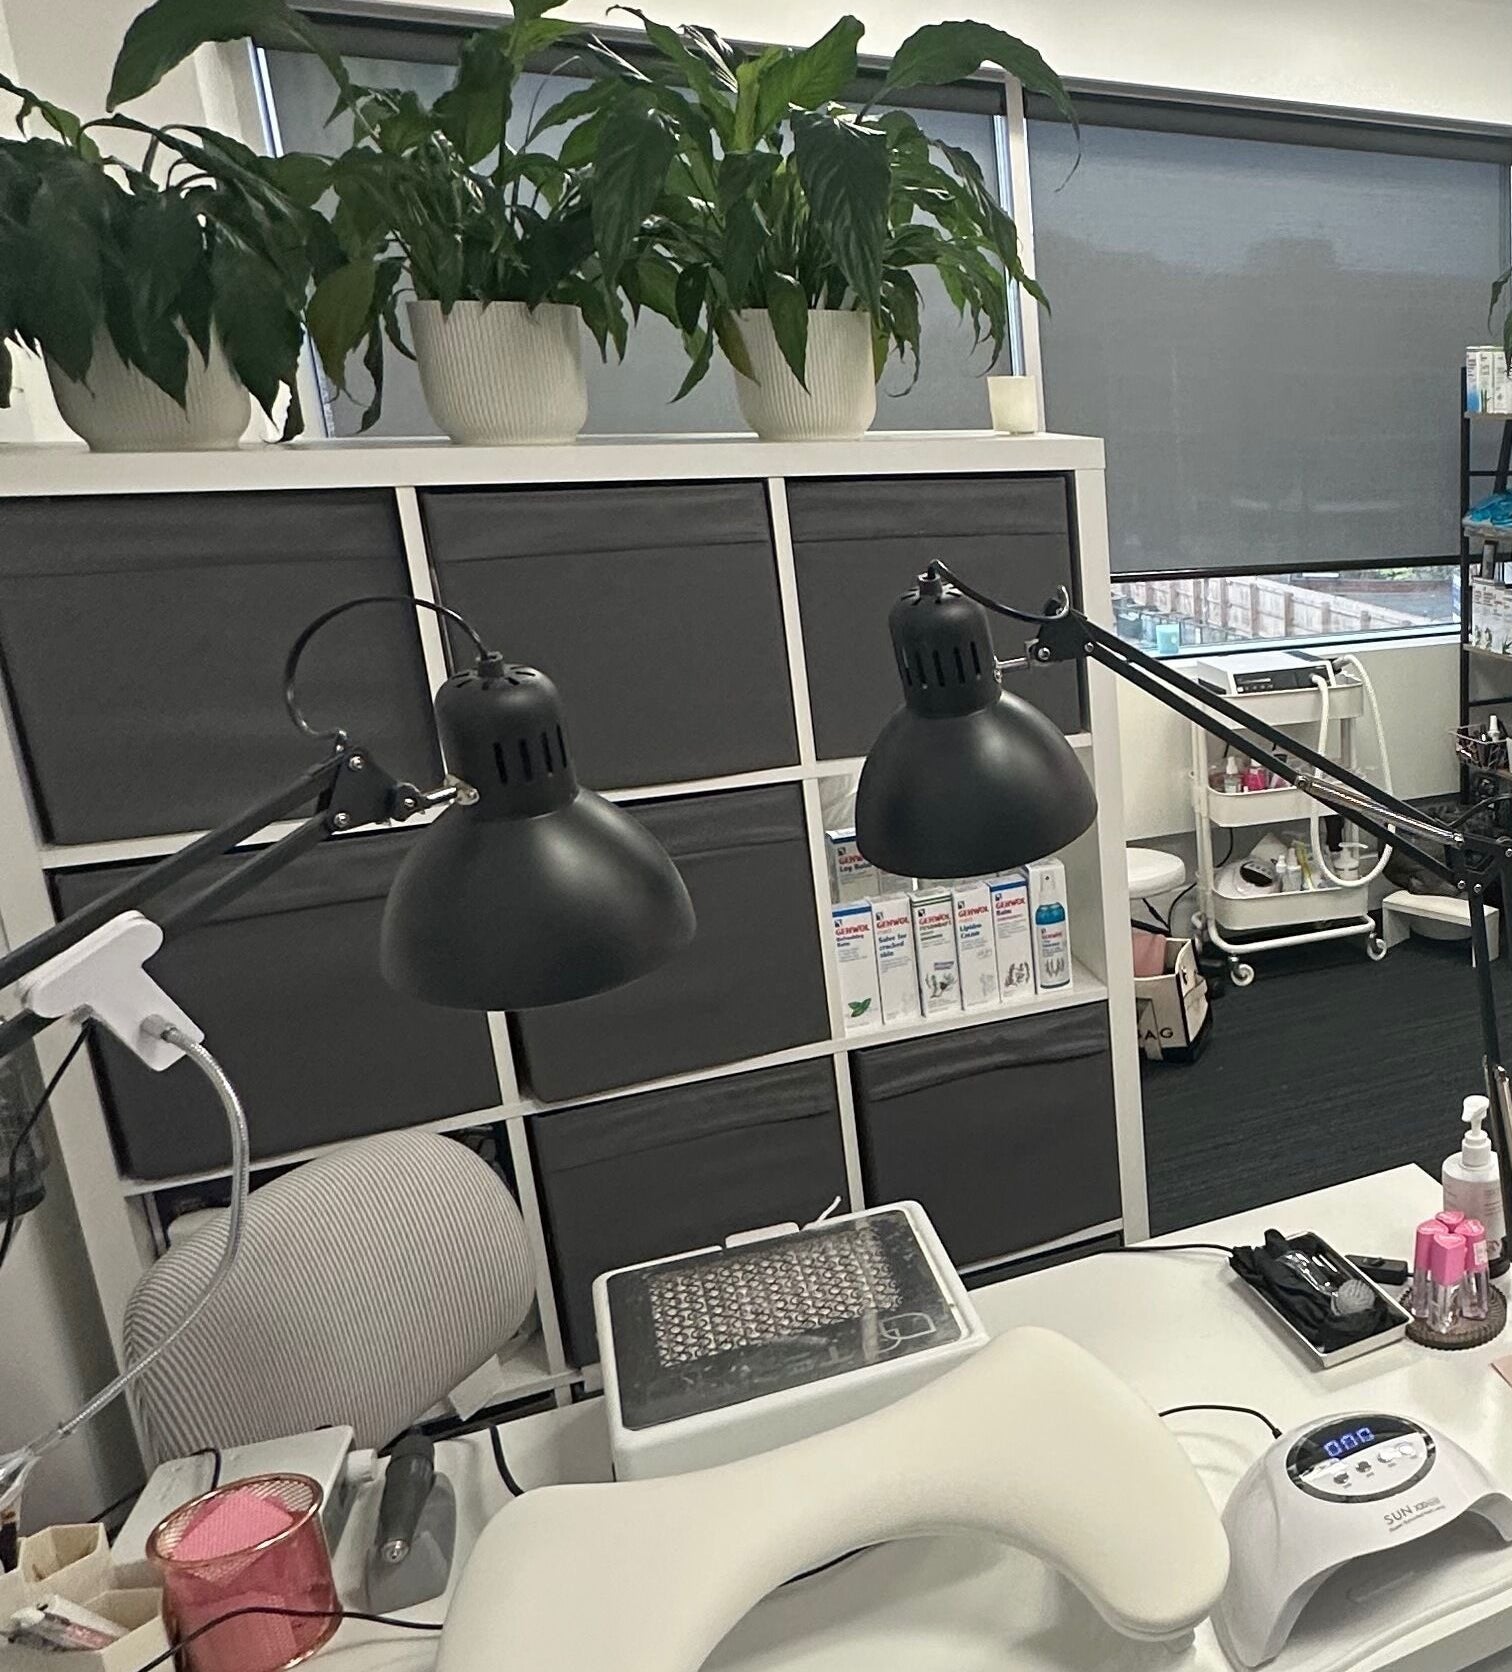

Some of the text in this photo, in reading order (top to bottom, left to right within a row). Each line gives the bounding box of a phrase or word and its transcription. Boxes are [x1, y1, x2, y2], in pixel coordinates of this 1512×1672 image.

[957, 905, 990, 918] GEHWOL
[876, 916, 910, 929] GEHWOL
[835, 924, 870, 936] GEHWOL
[1137, 1027, 1174, 1040] AG
[1383, 1504, 1413, 1525] SUN
